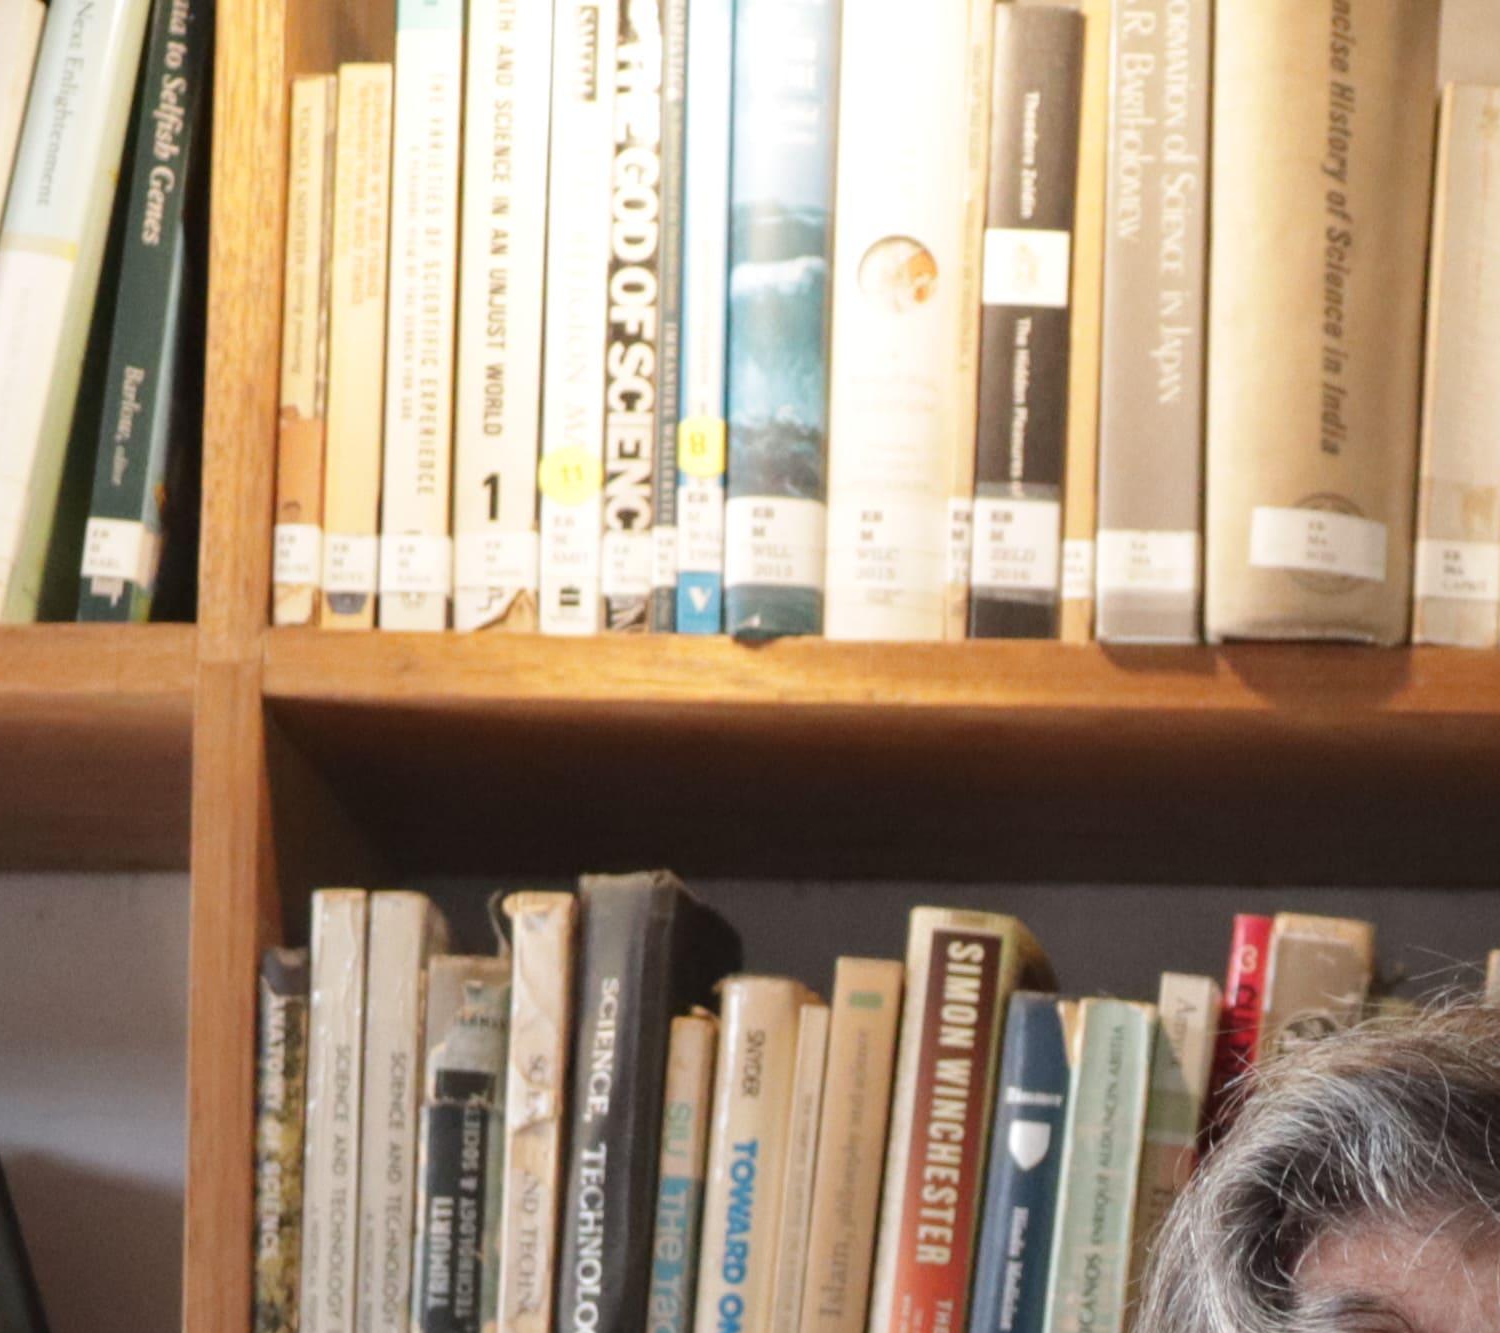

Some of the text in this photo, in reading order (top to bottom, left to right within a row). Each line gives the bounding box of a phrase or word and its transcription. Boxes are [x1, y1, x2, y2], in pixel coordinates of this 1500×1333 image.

[140, 41, 191, 247] to Selfish Genes
[1019, 92, 1041, 218] Theodore Zeldin
[1321, 81, 1352, 456] History of Science in India
[113, 366, 146, 443] Barlow,
[1009, 317, 1031, 477] The Hidden Pleasures
[582, 977, 621, 1122] SCIENCE,
[916, 940, 983, 1265] SIMON WINCHESTER
[722, 1139, 757, 1283] TOWARD
